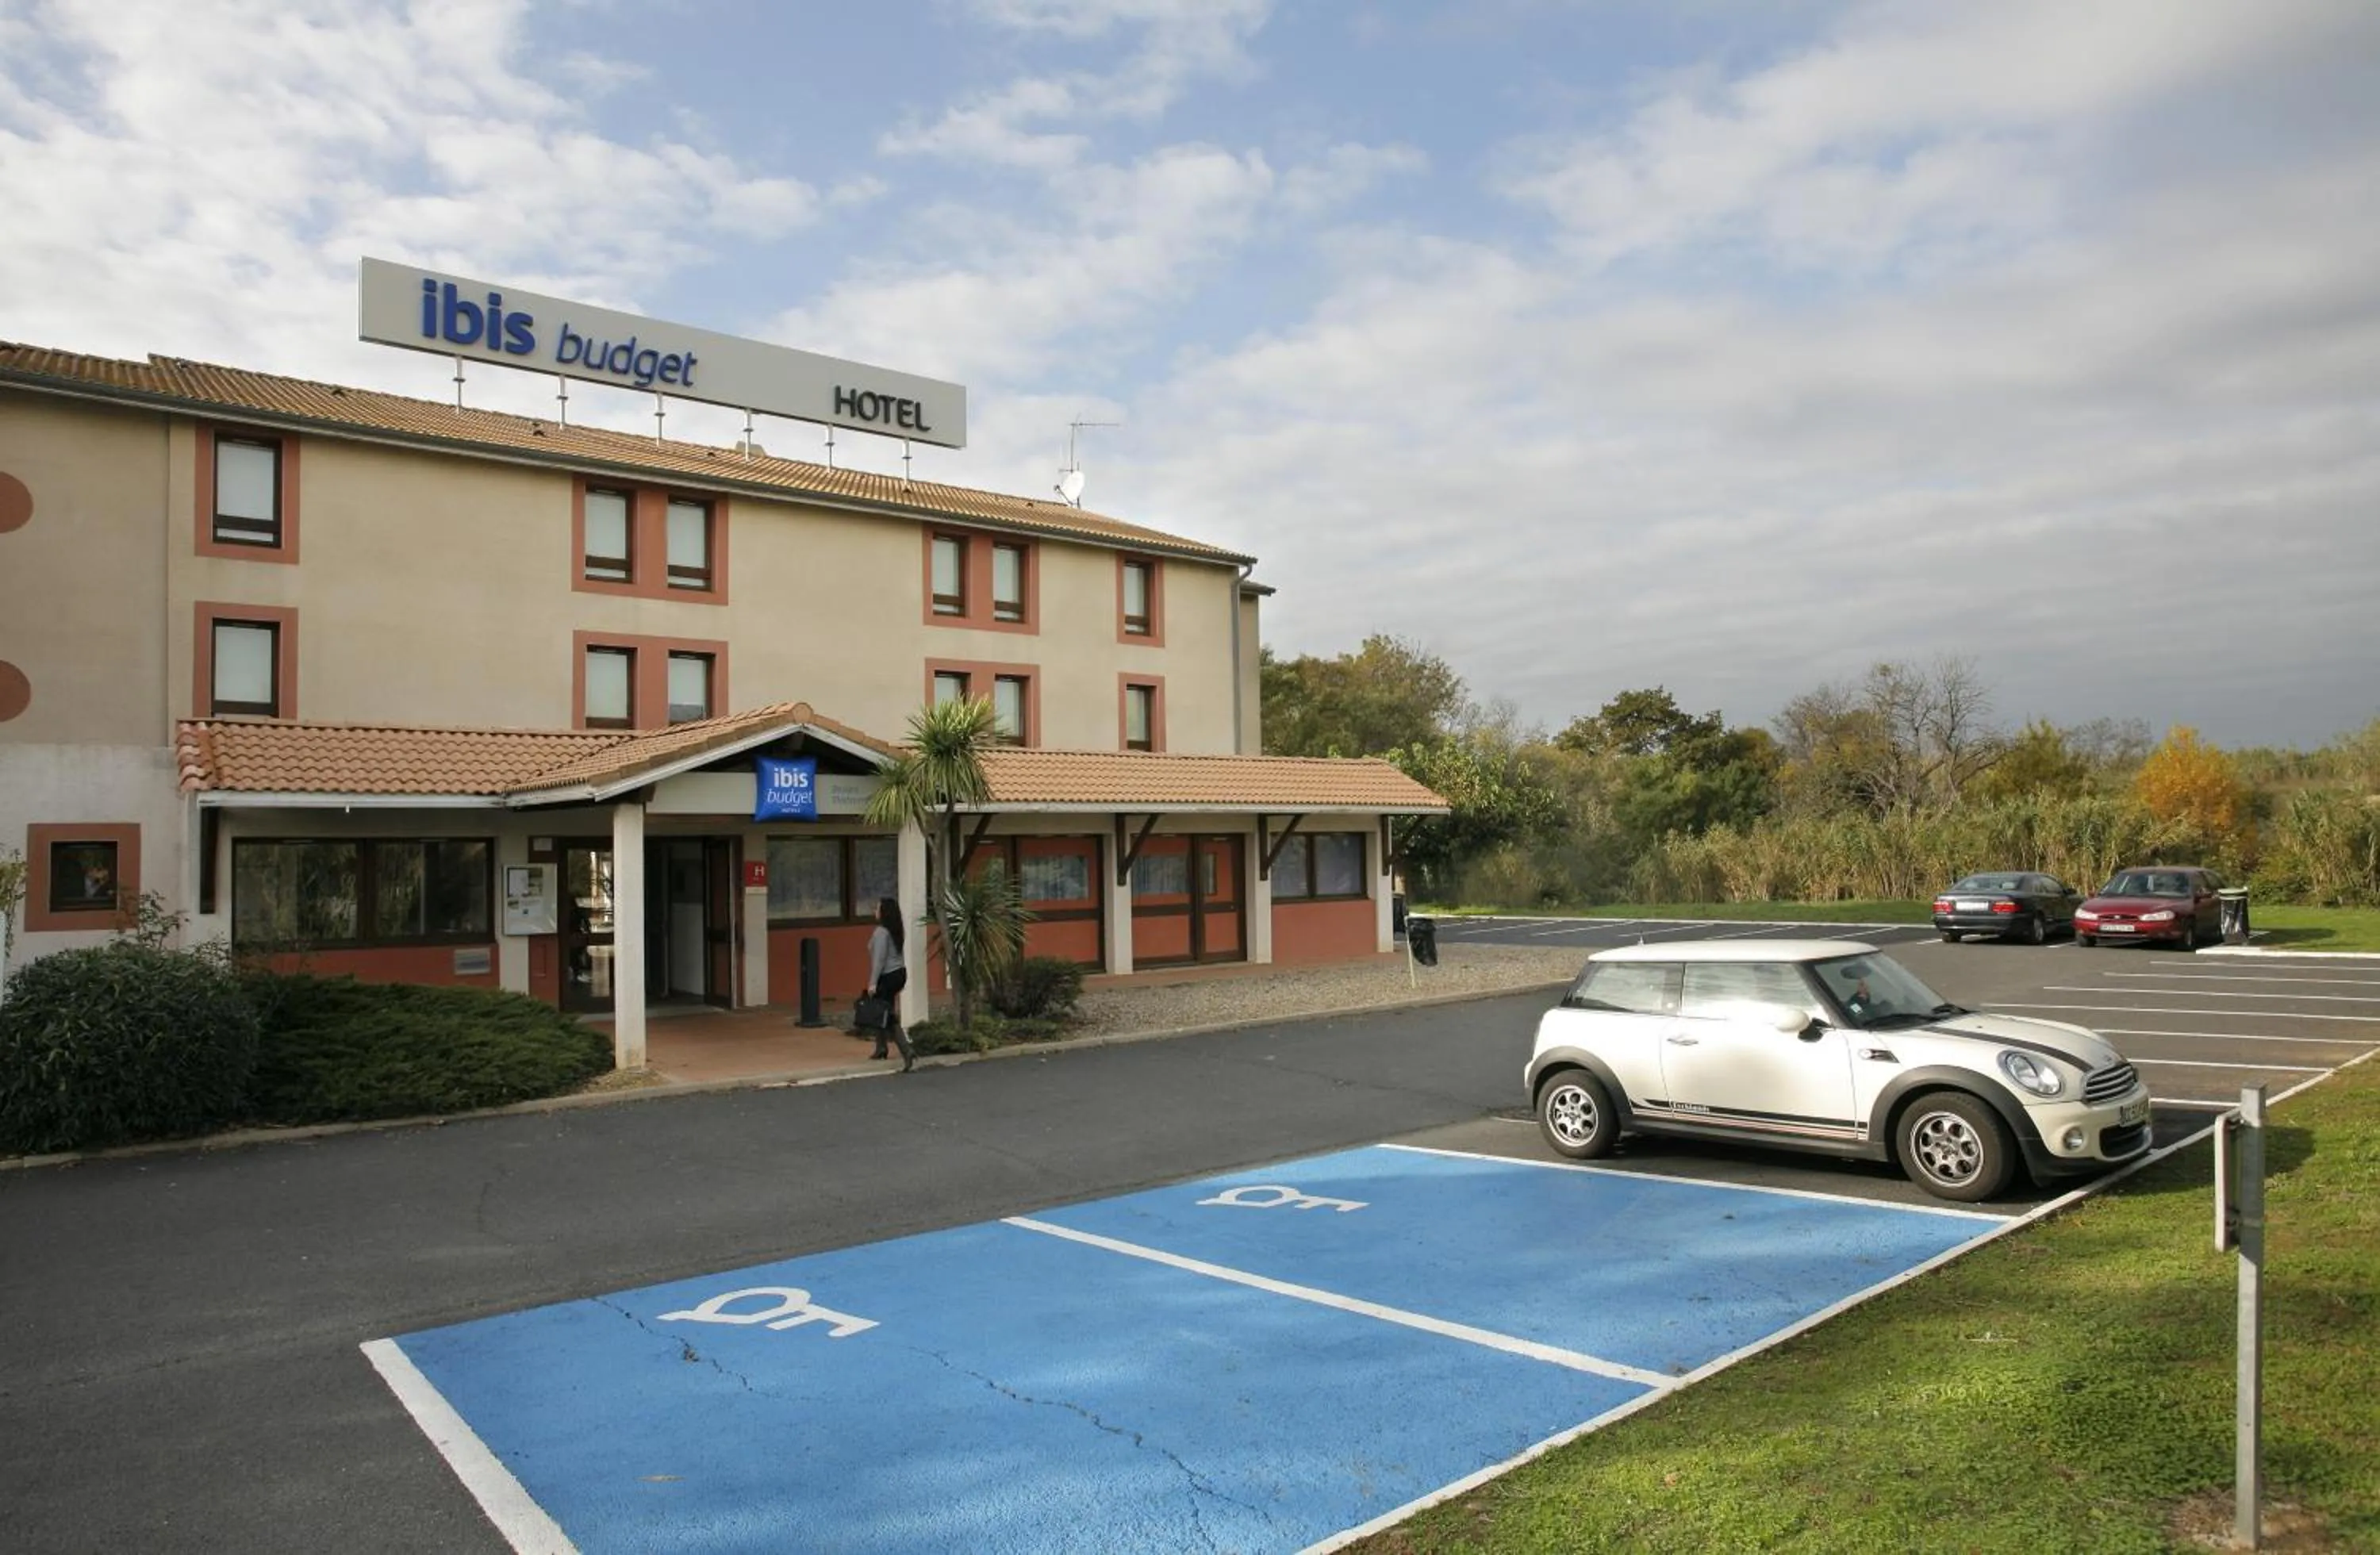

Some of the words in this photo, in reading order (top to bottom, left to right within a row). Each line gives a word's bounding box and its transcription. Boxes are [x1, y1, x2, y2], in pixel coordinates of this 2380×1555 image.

[423, 278, 536, 355] ibis
[556, 322, 698, 387] budget
[834, 385, 932, 432] HOTEL
[774, 767, 808, 788] ibis
[767, 788, 813, 807] budget
